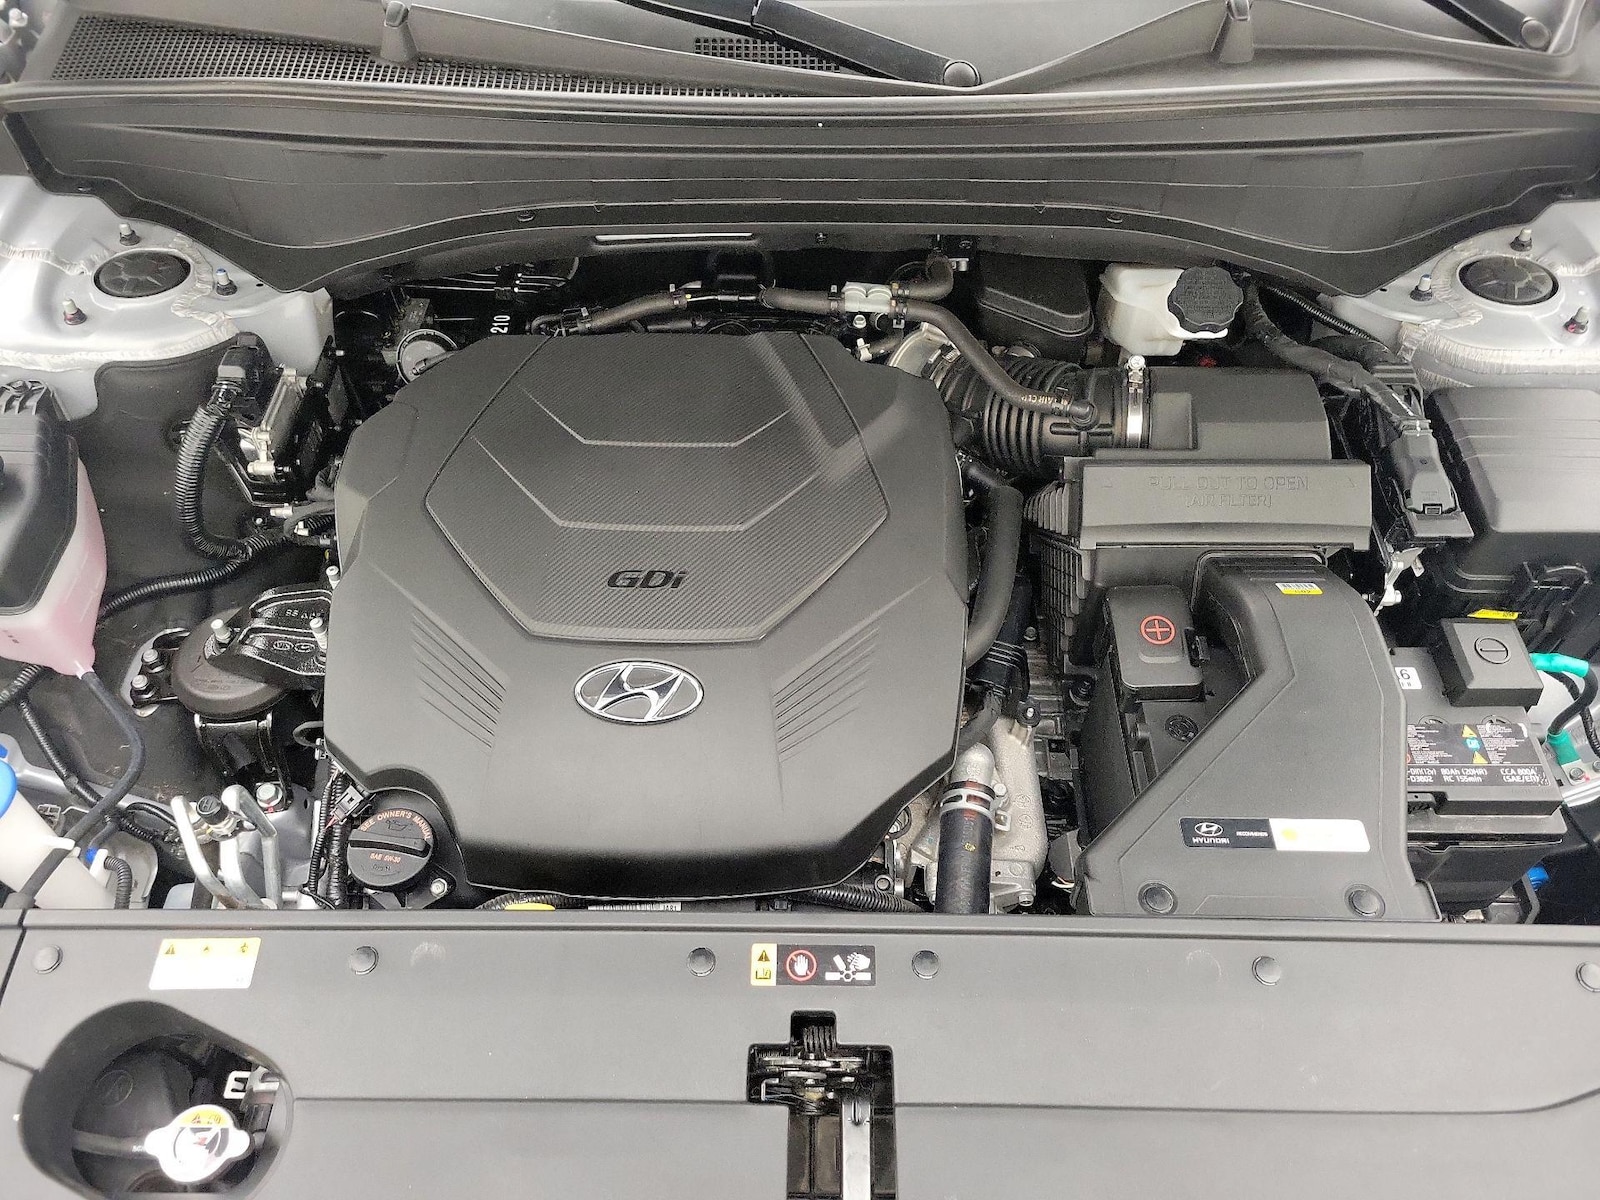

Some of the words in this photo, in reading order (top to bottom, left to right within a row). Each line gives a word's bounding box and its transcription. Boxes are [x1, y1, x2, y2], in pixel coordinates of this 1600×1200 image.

[489, 314, 511, 334] 210
[1148, 476, 1190, 490] PULL
[1196, 476, 1231, 490] OUT
[1237, 476, 1258, 490] TO
[1263, 476, 1309, 491] OPEN
[607, 570, 686, 588] GDi
[1443, 775, 1455, 783] RC
[360, 819, 376, 832] SEE
[377, 810, 413, 821] OWNER'S
[413, 815, 431, 841] MANUAL
